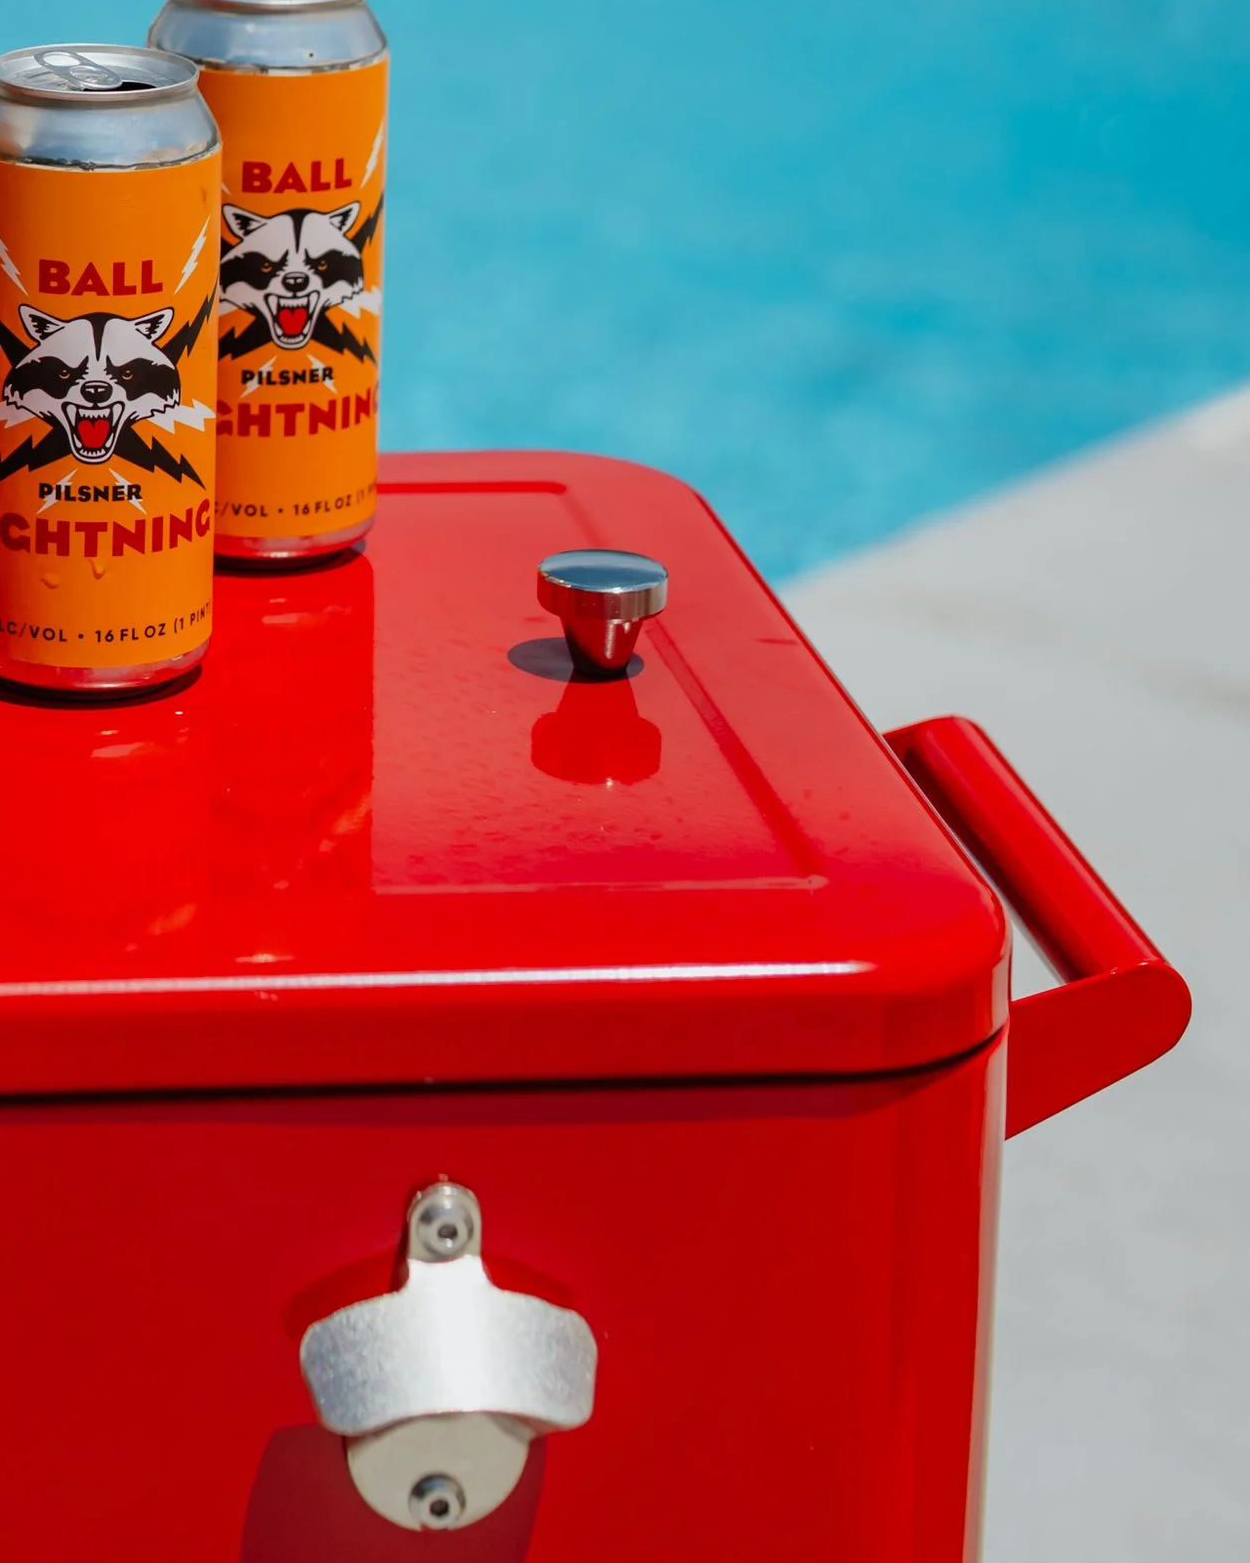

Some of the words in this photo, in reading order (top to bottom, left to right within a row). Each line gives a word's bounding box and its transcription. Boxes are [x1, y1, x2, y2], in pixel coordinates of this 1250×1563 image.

[241, 158, 353, 194] BALL
[38, 259, 164, 296] BALL
[241, 367, 335, 386] PILSNER
[38, 482, 142, 502] PILSNER
[293, 503, 310, 516] 16
[94, 629, 115, 643] 16
